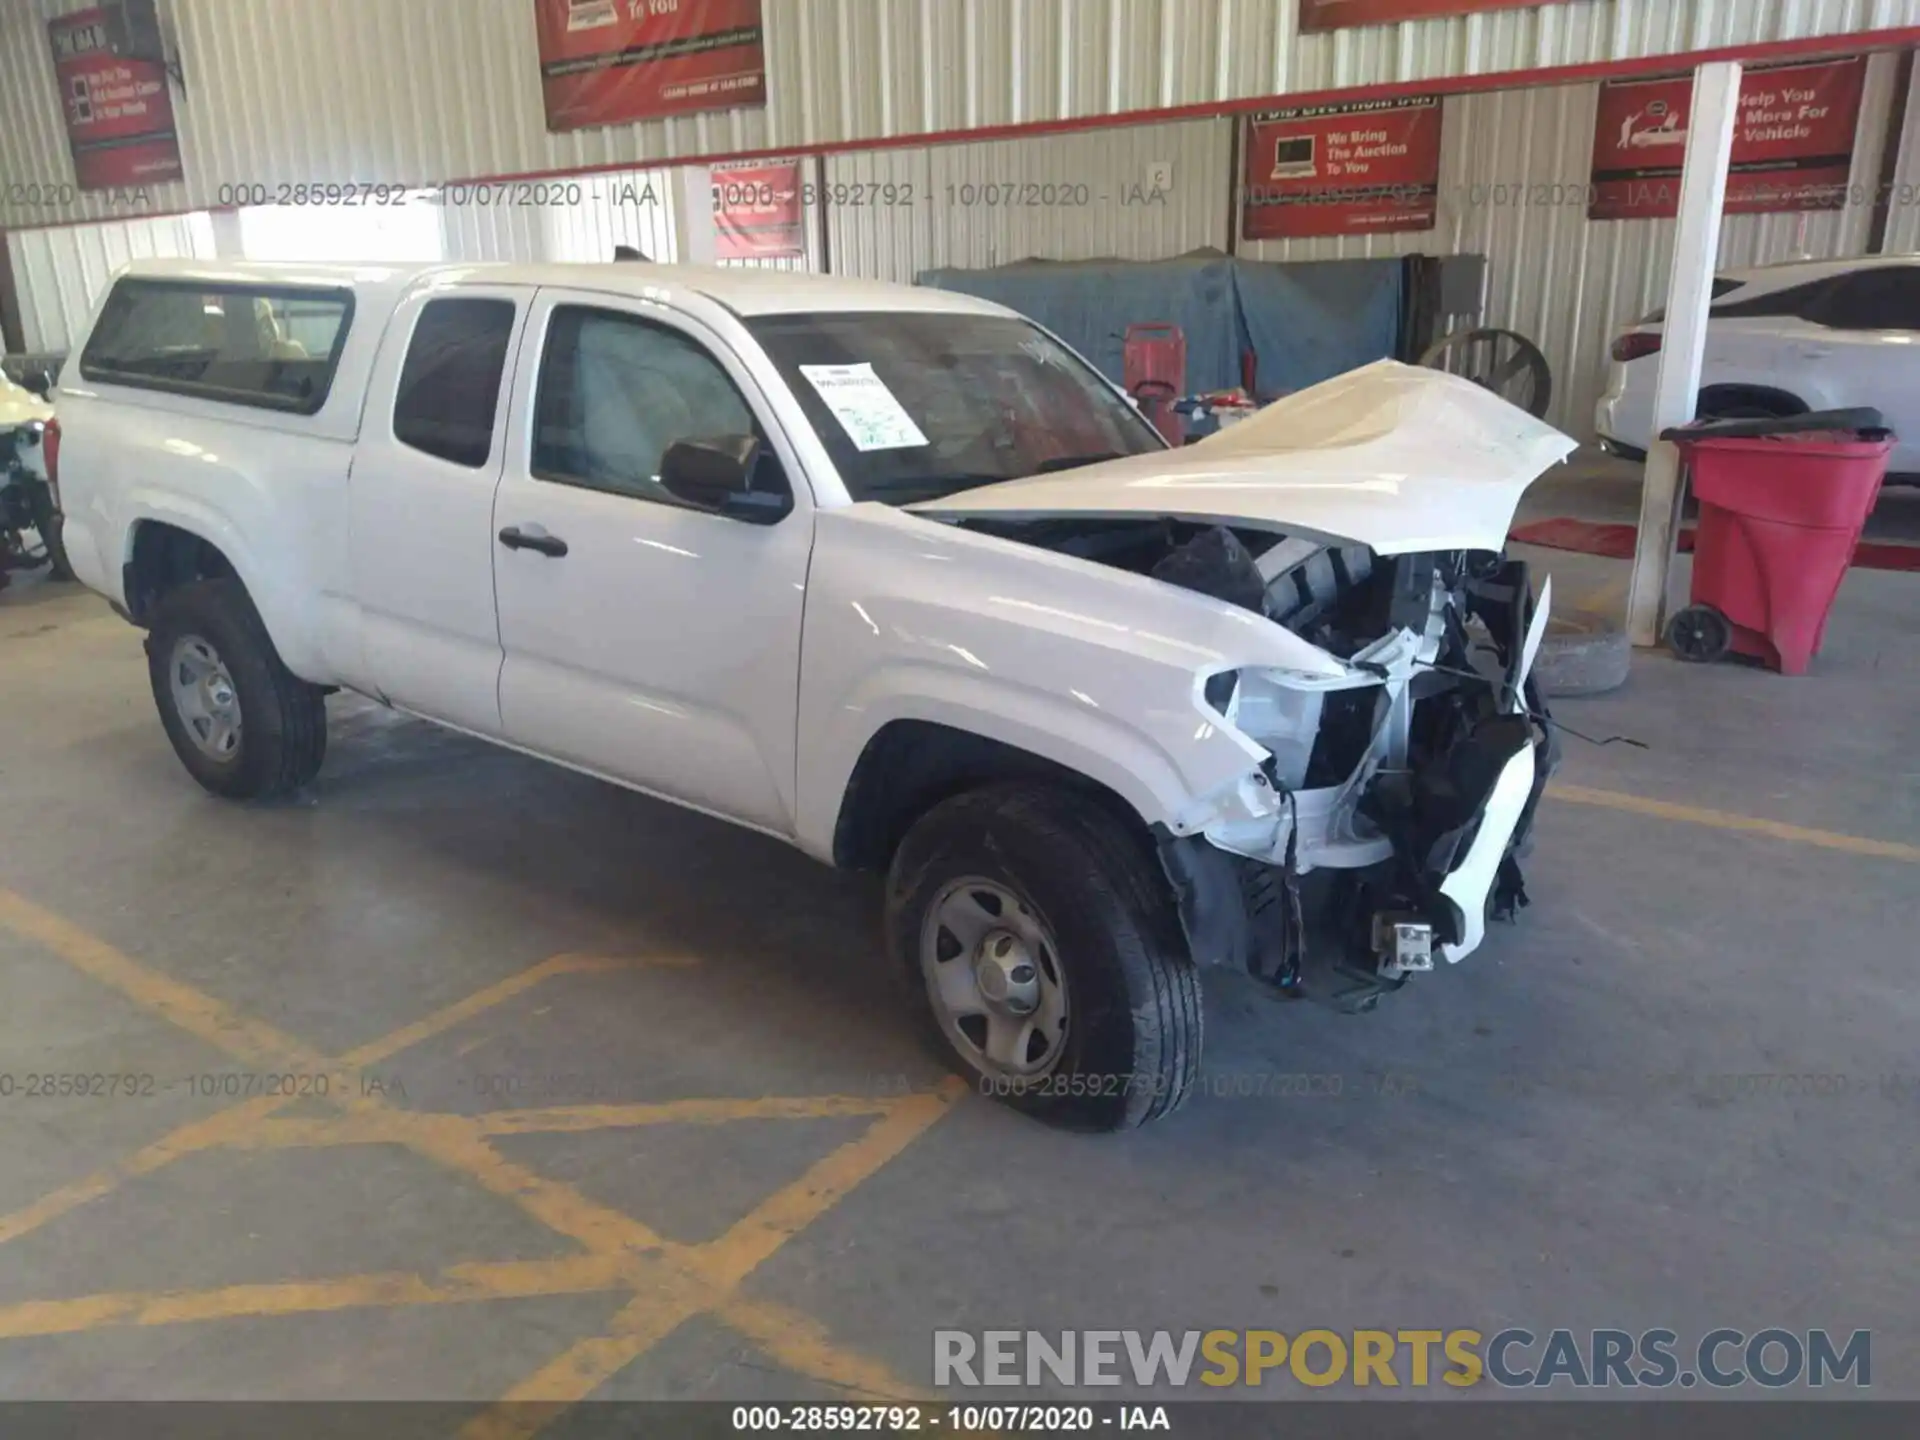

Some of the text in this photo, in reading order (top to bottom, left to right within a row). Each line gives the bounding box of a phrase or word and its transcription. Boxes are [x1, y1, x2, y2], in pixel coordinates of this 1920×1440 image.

[628, 1, 644, 20] To
[1782, 87, 1816, 103] You
[1745, 105, 1830, 125] More For
[1326, 130, 1388, 145] We Bring
[1744, 124, 1812, 142] Vehicle
[1327, 143, 1408, 161] The Auction
[1326, 161, 1370, 176] To You
